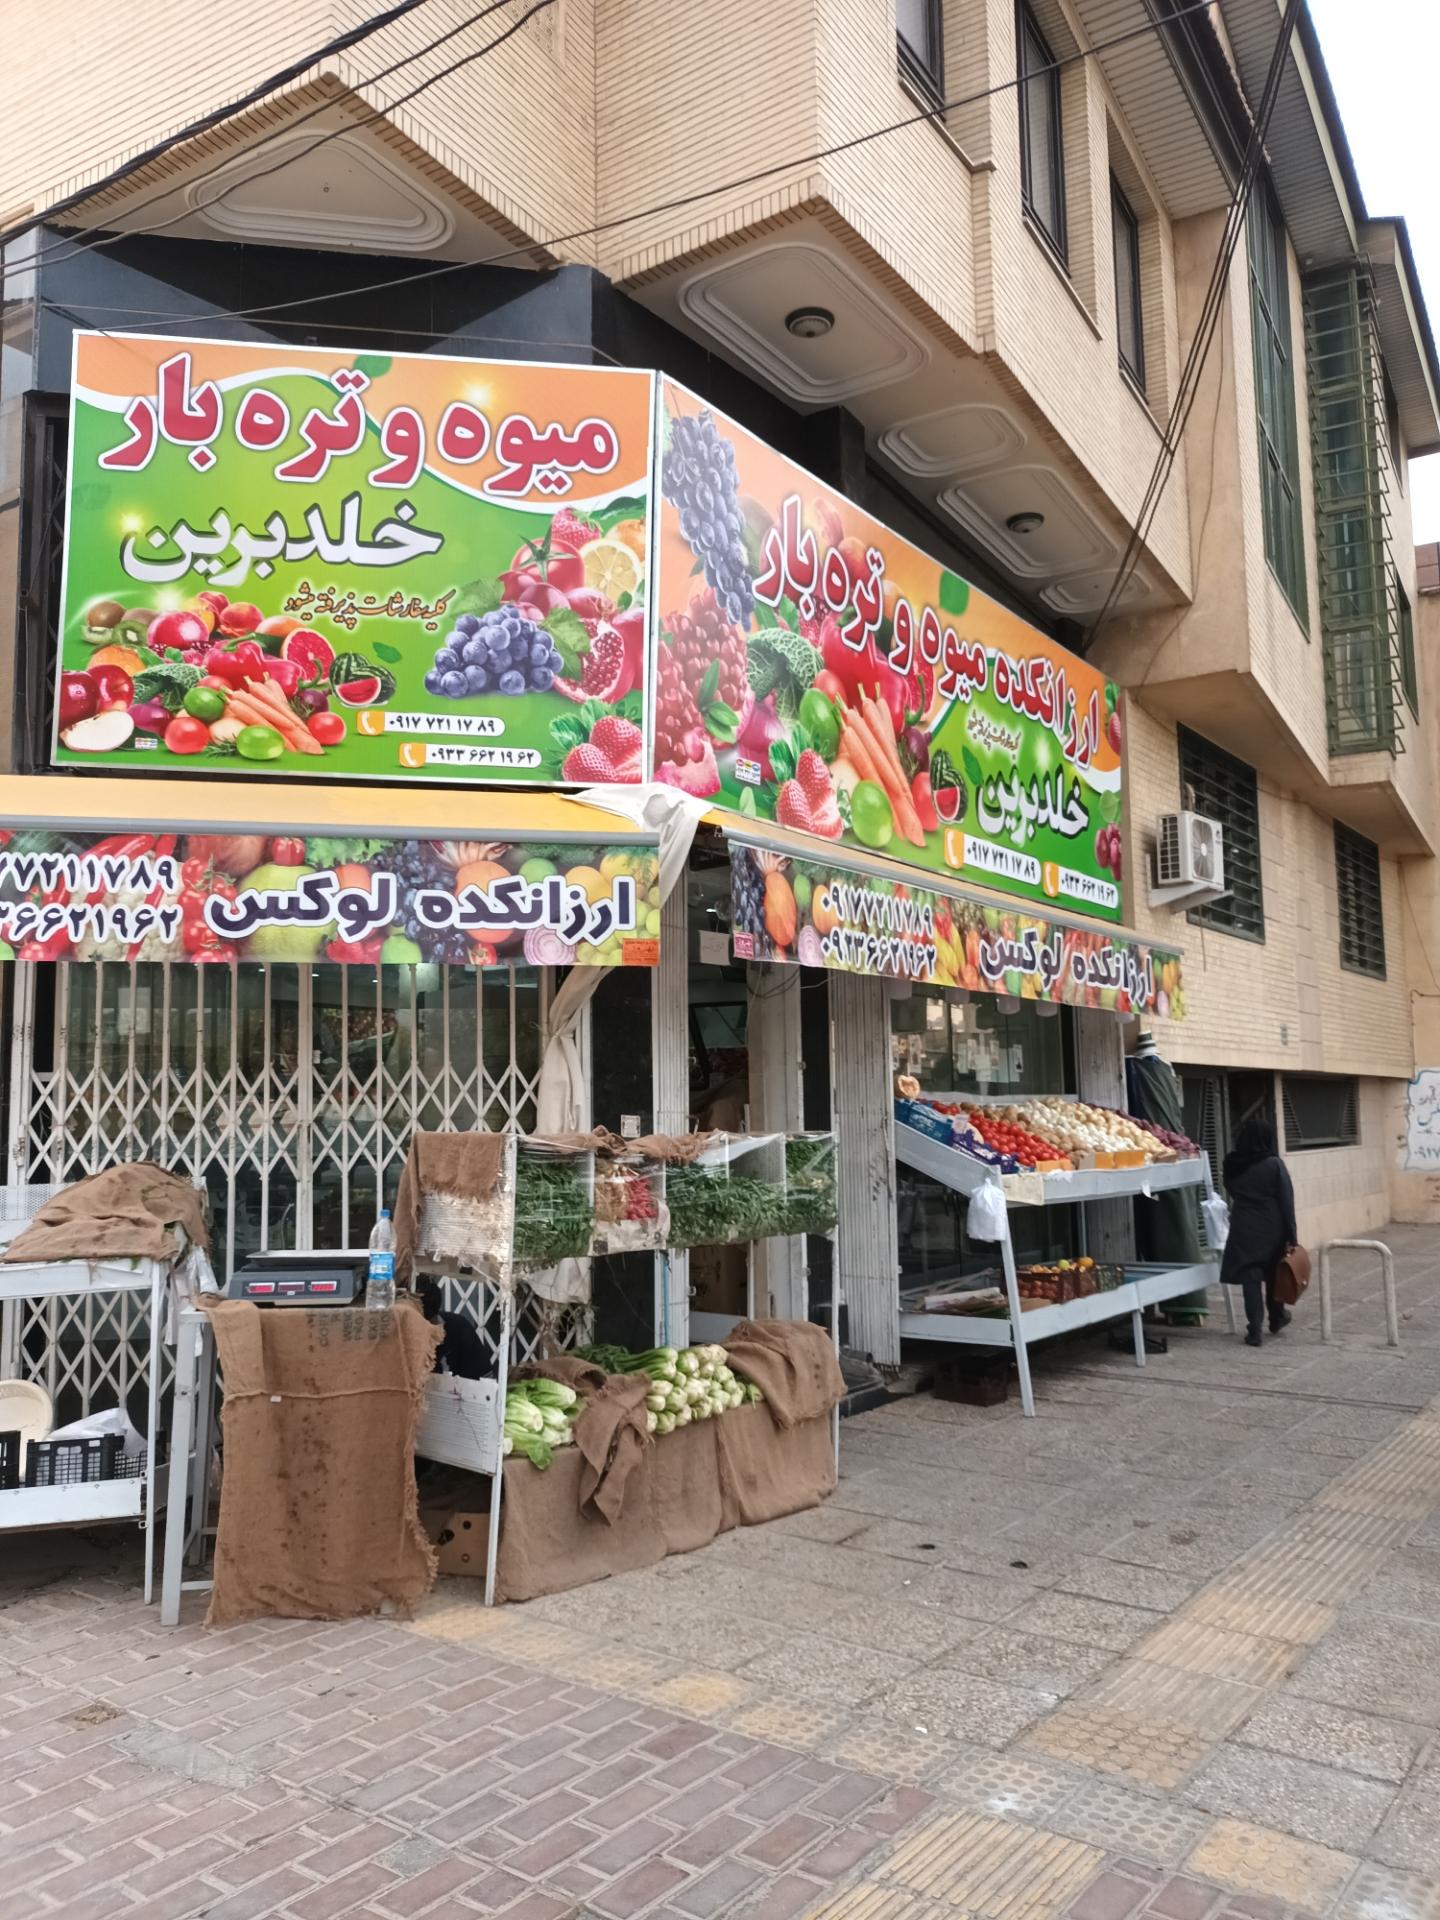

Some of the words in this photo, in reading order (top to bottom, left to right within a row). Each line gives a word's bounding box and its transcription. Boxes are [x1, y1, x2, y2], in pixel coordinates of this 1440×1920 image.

[99, 351, 225, 473] بار
[235, 367, 372, 484] تره
[367, 406, 426, 488] و
[440, 401, 620, 495] میوه
[752, 494, 818, 621] بار
[823, 547, 885, 652] تره
[888, 599, 914, 675] و
[921, 606, 987, 703] میوه
[389, 715, 421, 729] ۰۹۱۷
[426, 717, 451, 730] ۷۲۱
[457, 719, 473, 731] ۱۷
[477, 720, 495, 733] ۸۹
[993, 652, 1099, 769] ارزانکده
[431, 747, 465, 761] ۰۹۳۳
[469, 749, 496, 762] ۶۶۲
[500, 751, 513, 764] ۱۹
[517, 752, 535, 764] ۶۲
[204, 872, 398, 941] لوکس
[416, 876, 635, 945] ارزانکده
[979, 928, 1064, 991] لوکس
[1071, 946, 1153, 1007] ارزانکده
